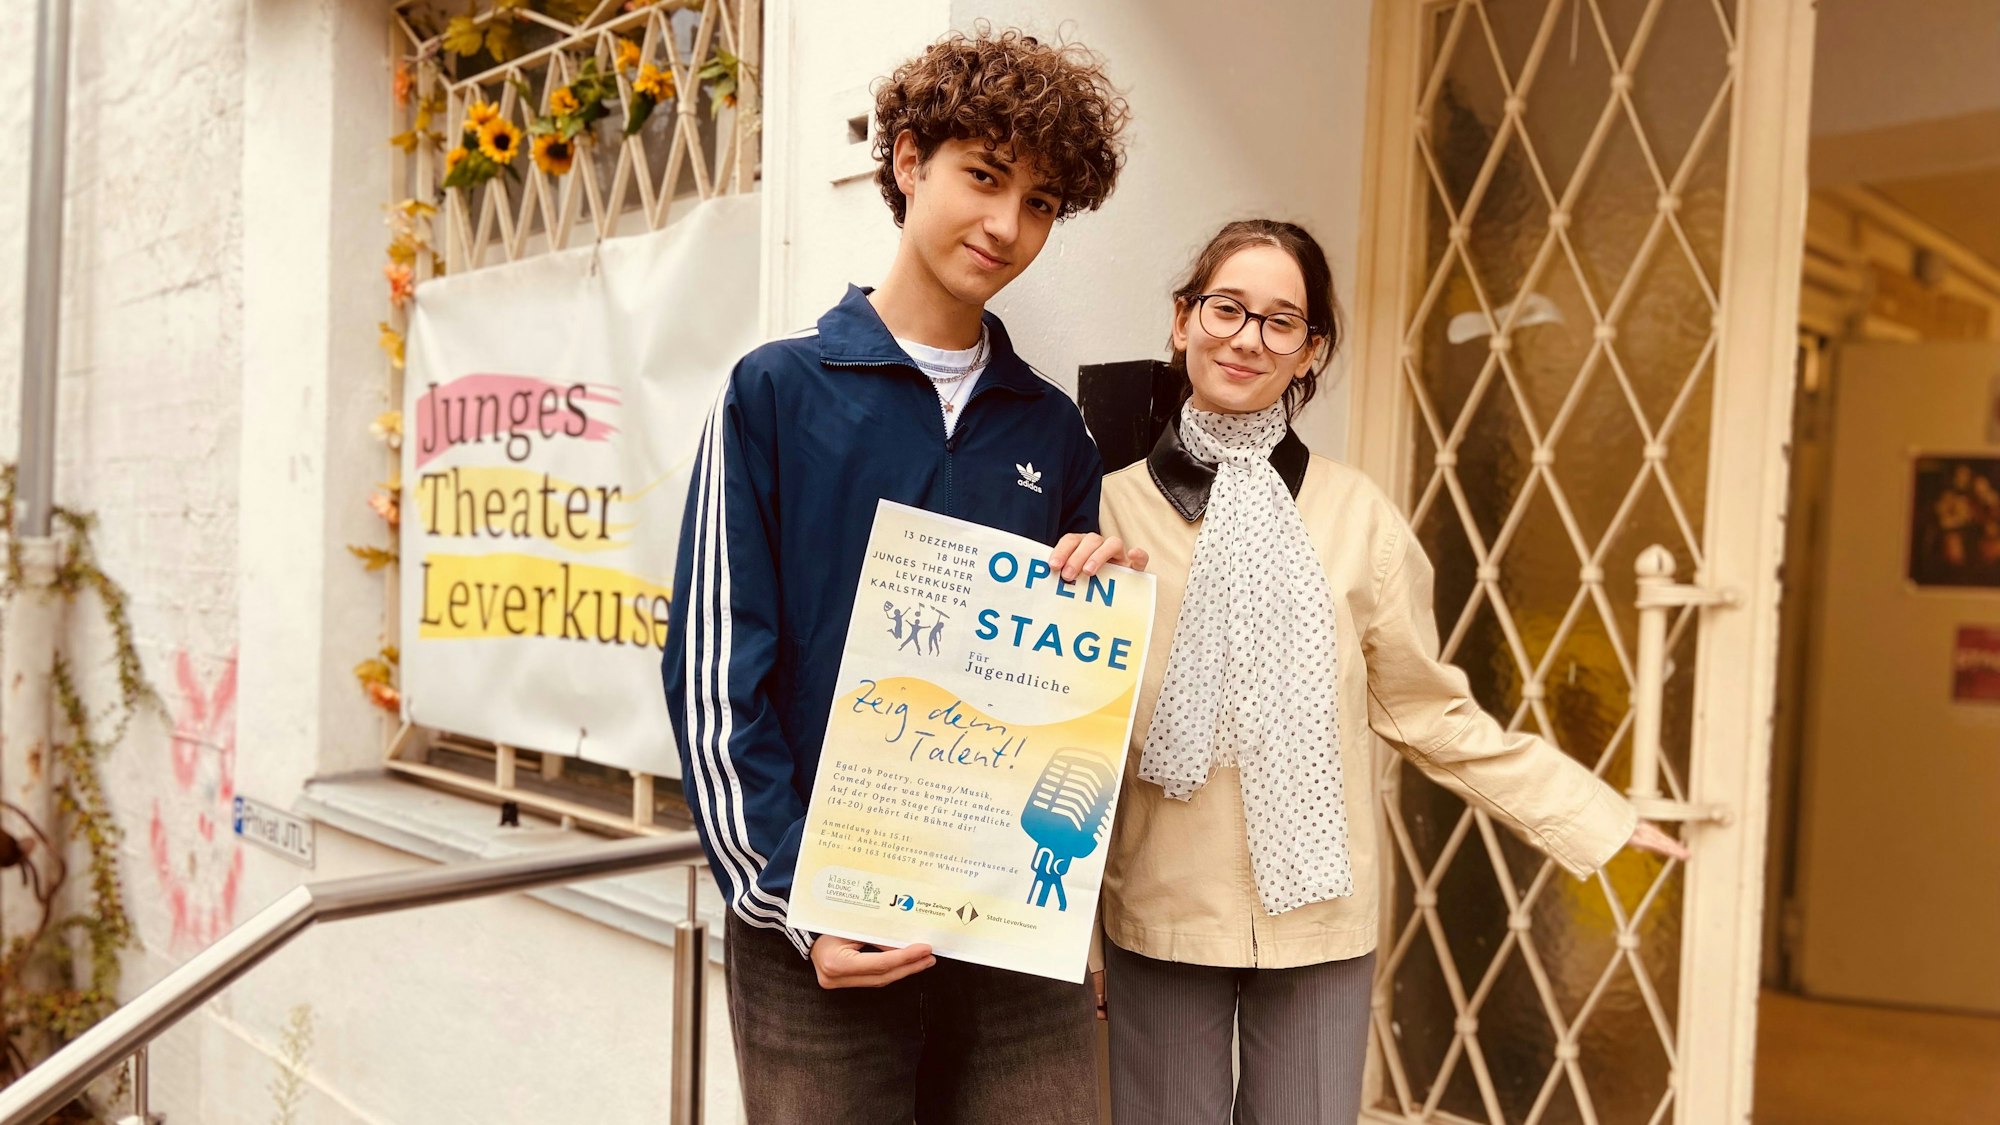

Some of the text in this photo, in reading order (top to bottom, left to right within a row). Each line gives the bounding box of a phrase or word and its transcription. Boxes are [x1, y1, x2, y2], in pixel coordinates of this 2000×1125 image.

[421, 382, 588, 463] Junges
[1017, 479, 1043, 494] adidas
[420, 467, 622, 540] Theater
[904, 530, 979, 556] 13 DEZEMBER
[872, 551, 974, 582] JUNGES THEATER
[937, 552, 976, 569] 18 UHR
[870, 578, 967, 608] KARLSTRAßE 9A
[895, 570, 971, 595] LEVERKUSEN
[975, 608, 1132, 671] STAGE
[968, 651, 990, 664] Für
[965, 661, 1071, 695] Jugendliche
[852, 679, 1007, 743] Zeig dein
[909, 730, 1028, 770] Talent!
[835, 760, 858, 772] Egal
[861, 766, 873, 774] ob
[833, 772, 872, 788] Comedy
[875, 783, 898, 792] oder
[901, 788, 920, 797] was
[924, 791, 968, 807] komplett
[827, 796, 977, 833] (14-20) gehört die Bühne dir!
[830, 784, 1011, 828] Auf der Open Stage für Jugendliche
[822, 819, 870, 836] Anmeldung
[873, 828, 886, 837] bis
[865, 848, 879, 857] 163
[937, 862, 979, 878] Whatsapp
[826, 889, 860, 900] LEVERKUSEN
[828, 874, 860, 887] klasse!
[915, 907, 946, 917] Leverkusen
[986, 914, 1038, 930] Stadt Leverkusen
